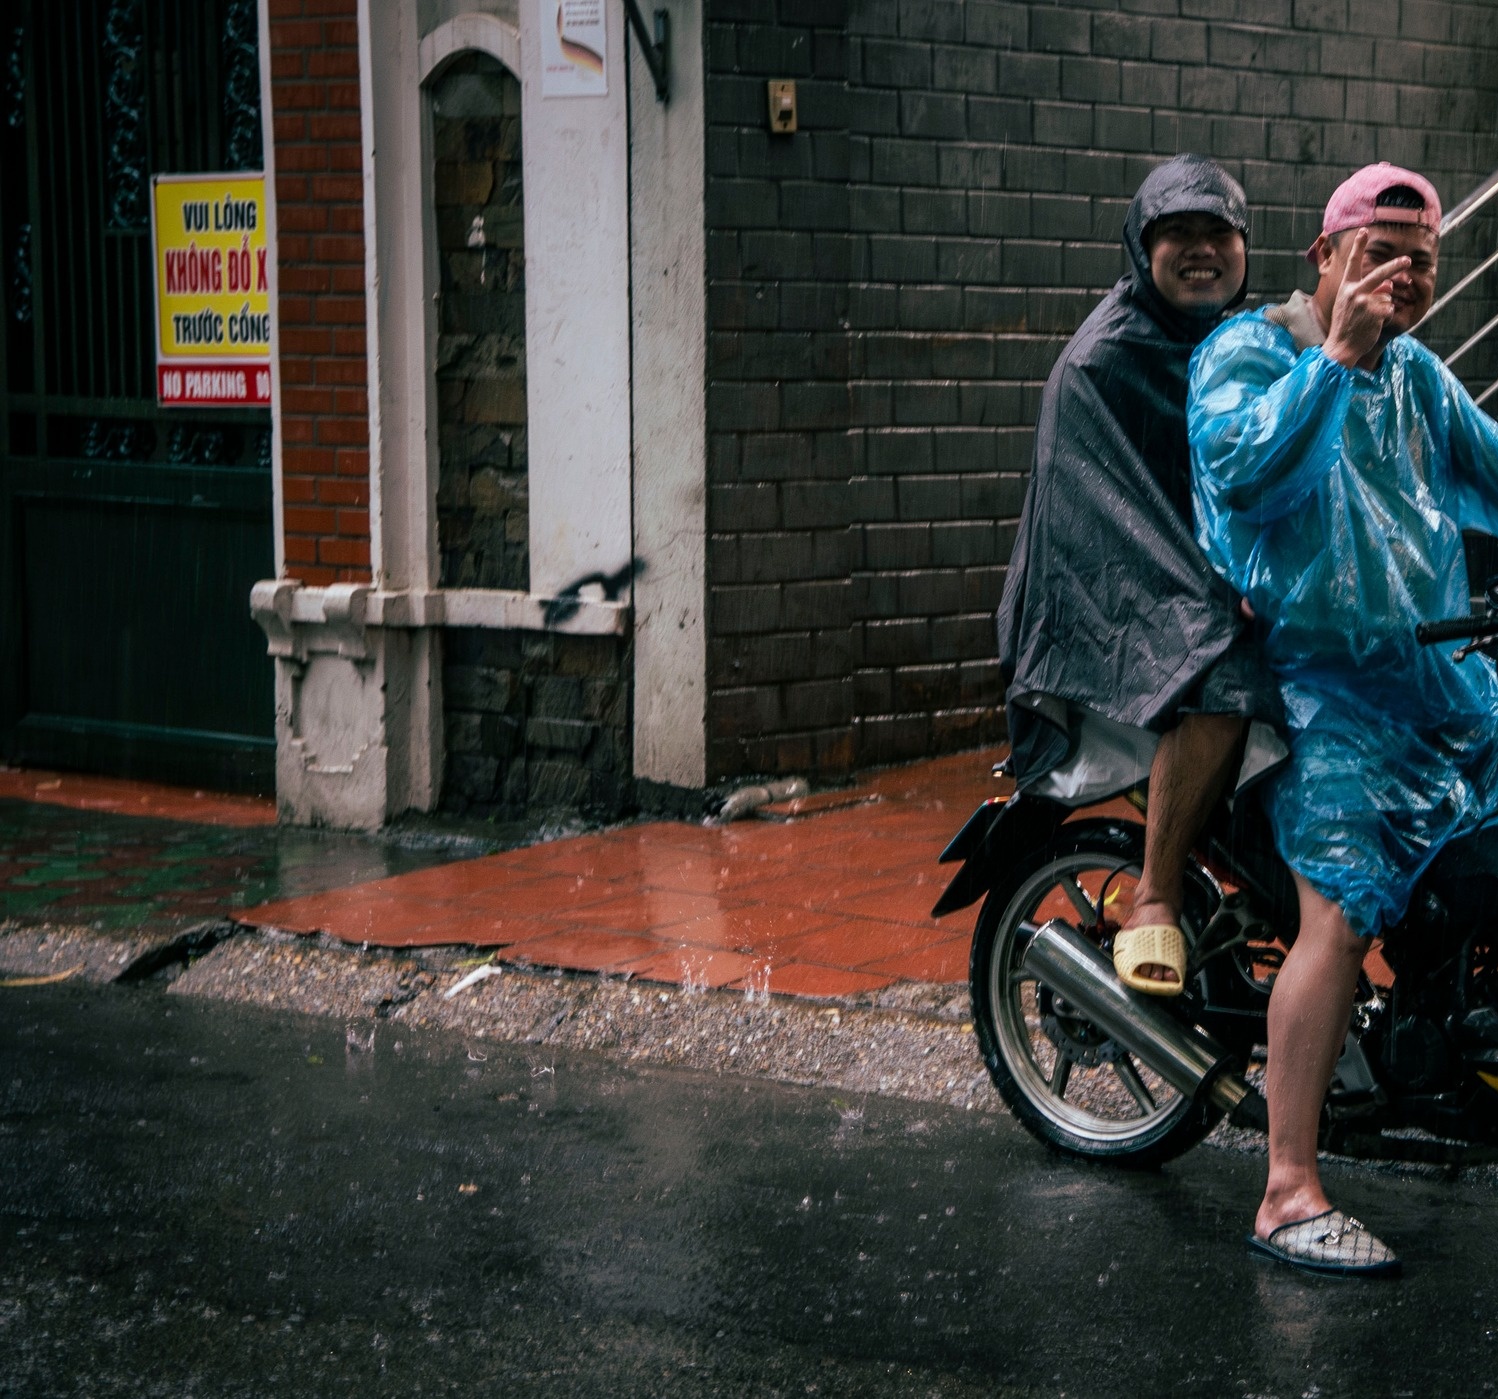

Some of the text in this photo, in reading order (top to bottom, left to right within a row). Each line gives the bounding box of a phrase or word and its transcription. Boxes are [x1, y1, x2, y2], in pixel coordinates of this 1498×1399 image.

[183, 202, 209, 232] VUI
[165, 241, 222, 294] KHÔNG
[256, 247, 268, 293] X
[172, 306, 224, 345] TRƯỚC
[163, 370, 182, 399] NO
[185, 370, 247, 399] PARKING
